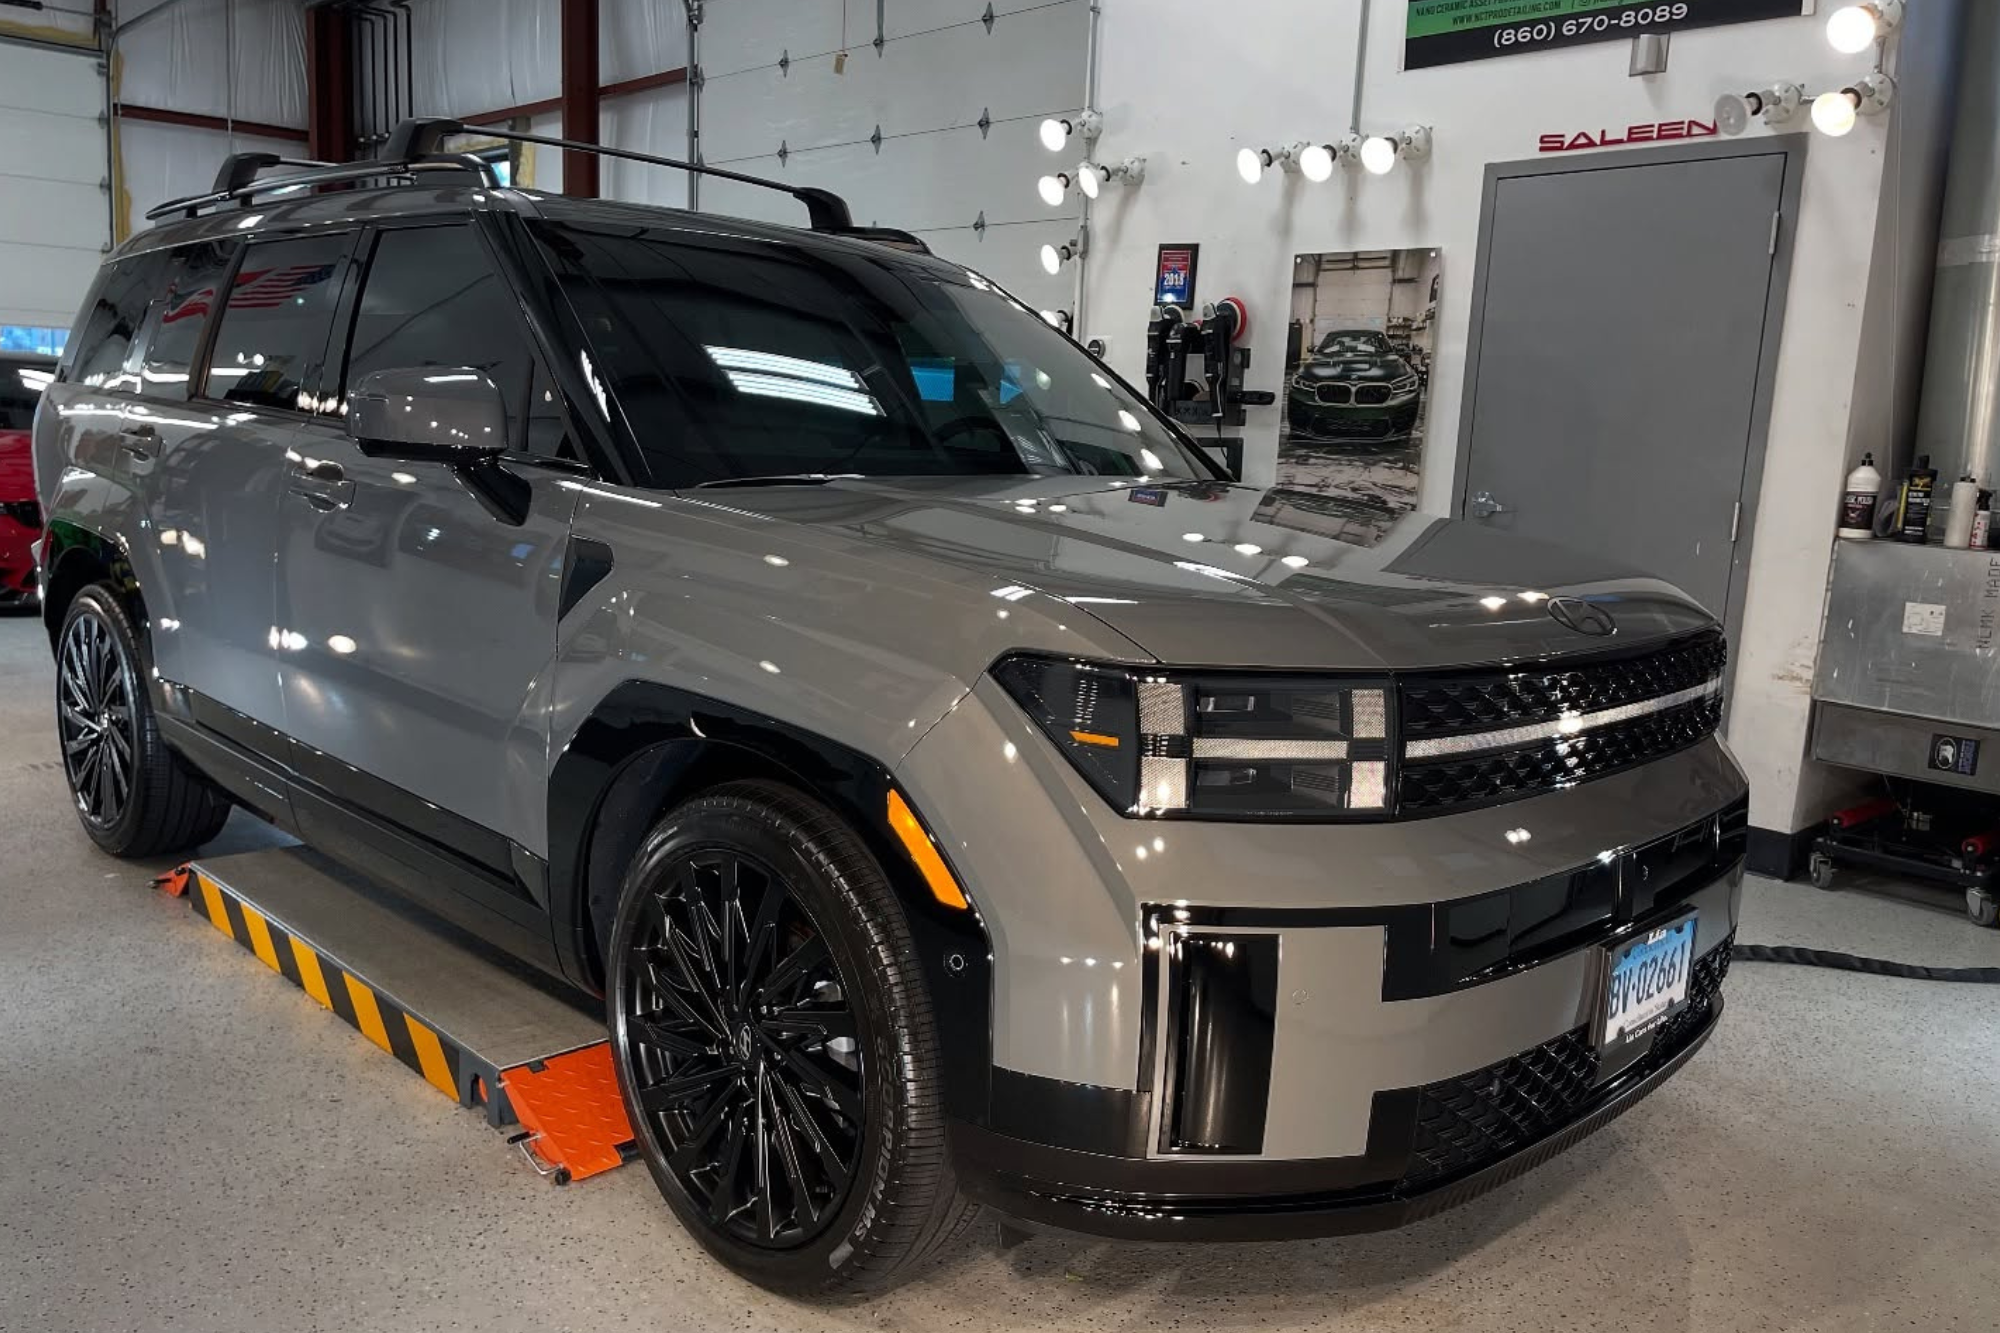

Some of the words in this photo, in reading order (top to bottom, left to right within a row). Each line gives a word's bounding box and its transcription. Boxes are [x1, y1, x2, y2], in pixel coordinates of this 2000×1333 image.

[1416, 5, 1436, 16] NANO
[1436, 1, 1467, 14] CERAMIC
[1494, 22, 1555, 47] (860)
[1562, 3, 1688, 36] 670-8089
[1539, 119, 1718, 152] SALEEN
[874, 1036, 894, 1201] SCORPION
